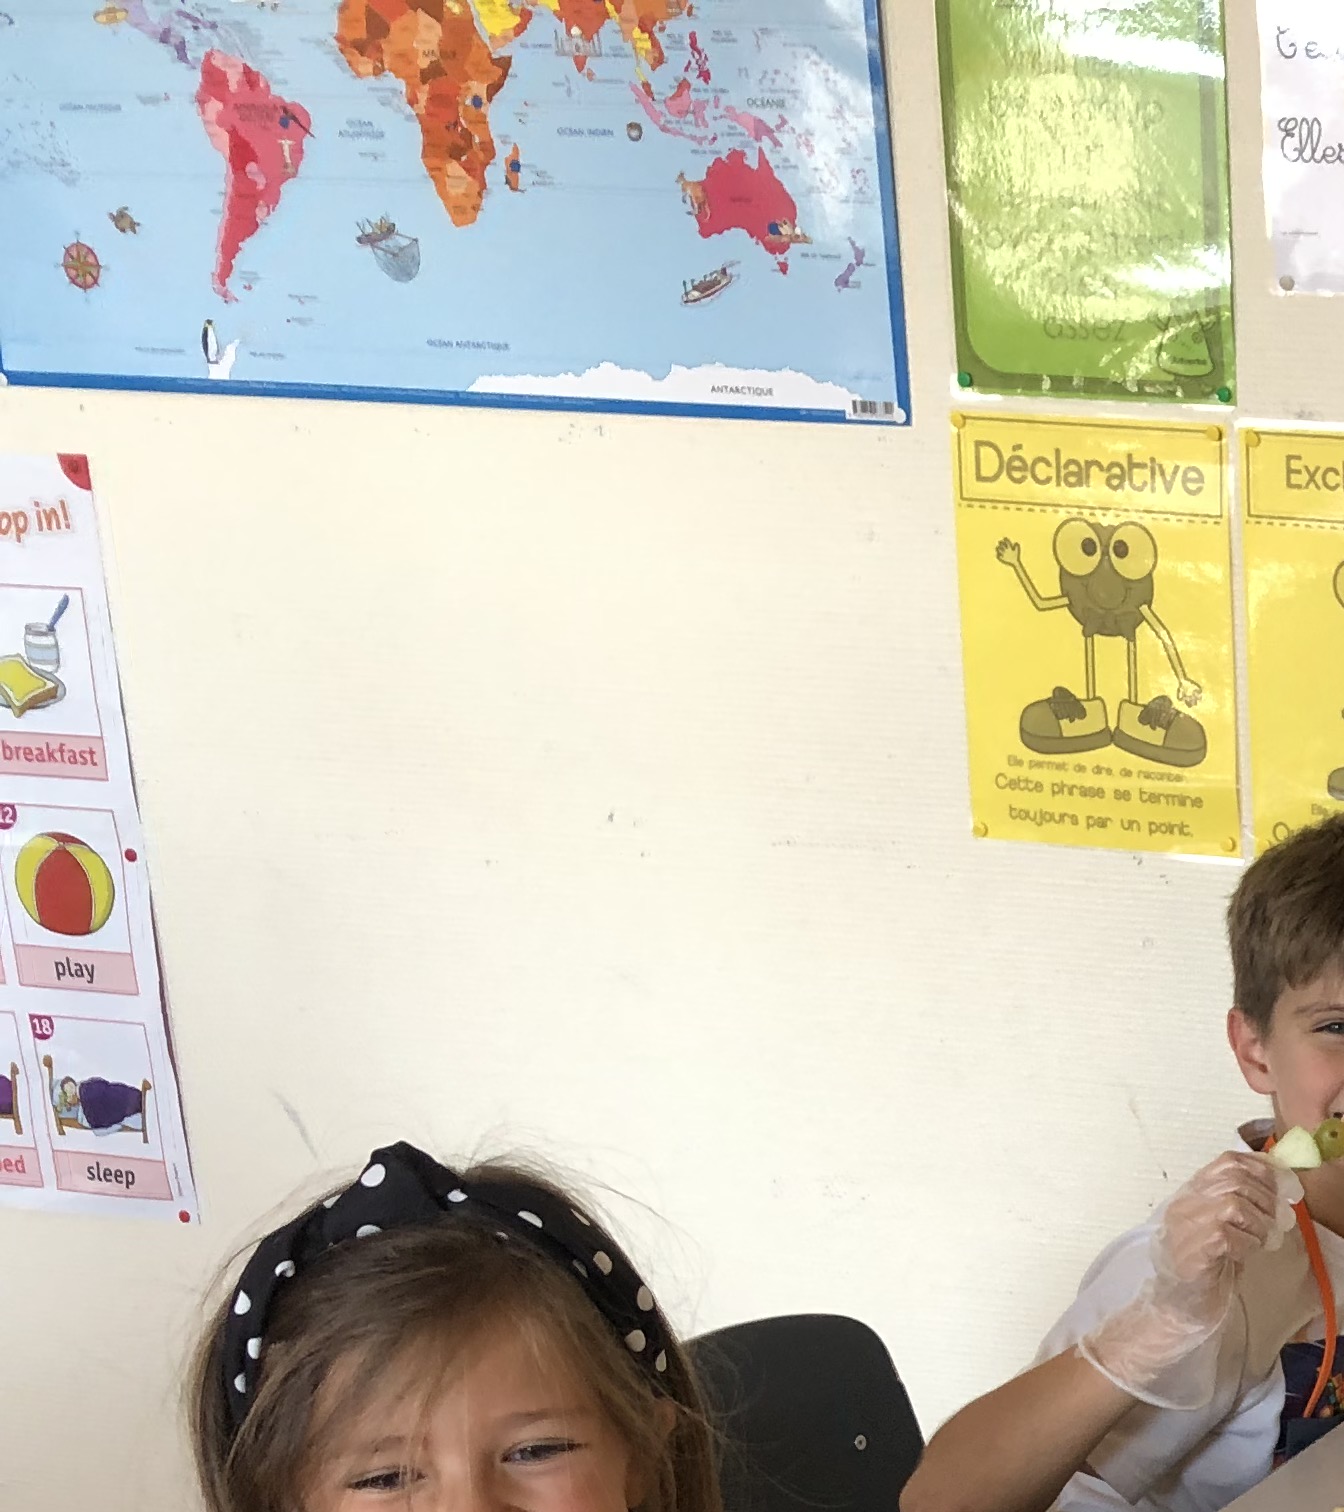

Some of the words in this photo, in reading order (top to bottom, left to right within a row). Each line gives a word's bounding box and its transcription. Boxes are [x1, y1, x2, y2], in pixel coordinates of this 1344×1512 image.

[973, 439, 1206, 496] Déclarative
[34, 499, 71, 533] in!
[1, 736, 98, 767] breakfast
[995, 773, 1044, 793] Cette
[1051, 781, 1106, 799] phrase
[1113, 788, 1132, 801] se
[1139, 787, 1204, 809] termine
[1009, 804, 1079, 827] toujours
[1086, 815, 1114, 830] par
[1121, 820, 1141, 832] un
[1149, 820, 1194, 837] point.
[54, 956, 95, 985] play
[32, 1015, 53, 1037] 18
[87, 1162, 136, 1189] sleep
